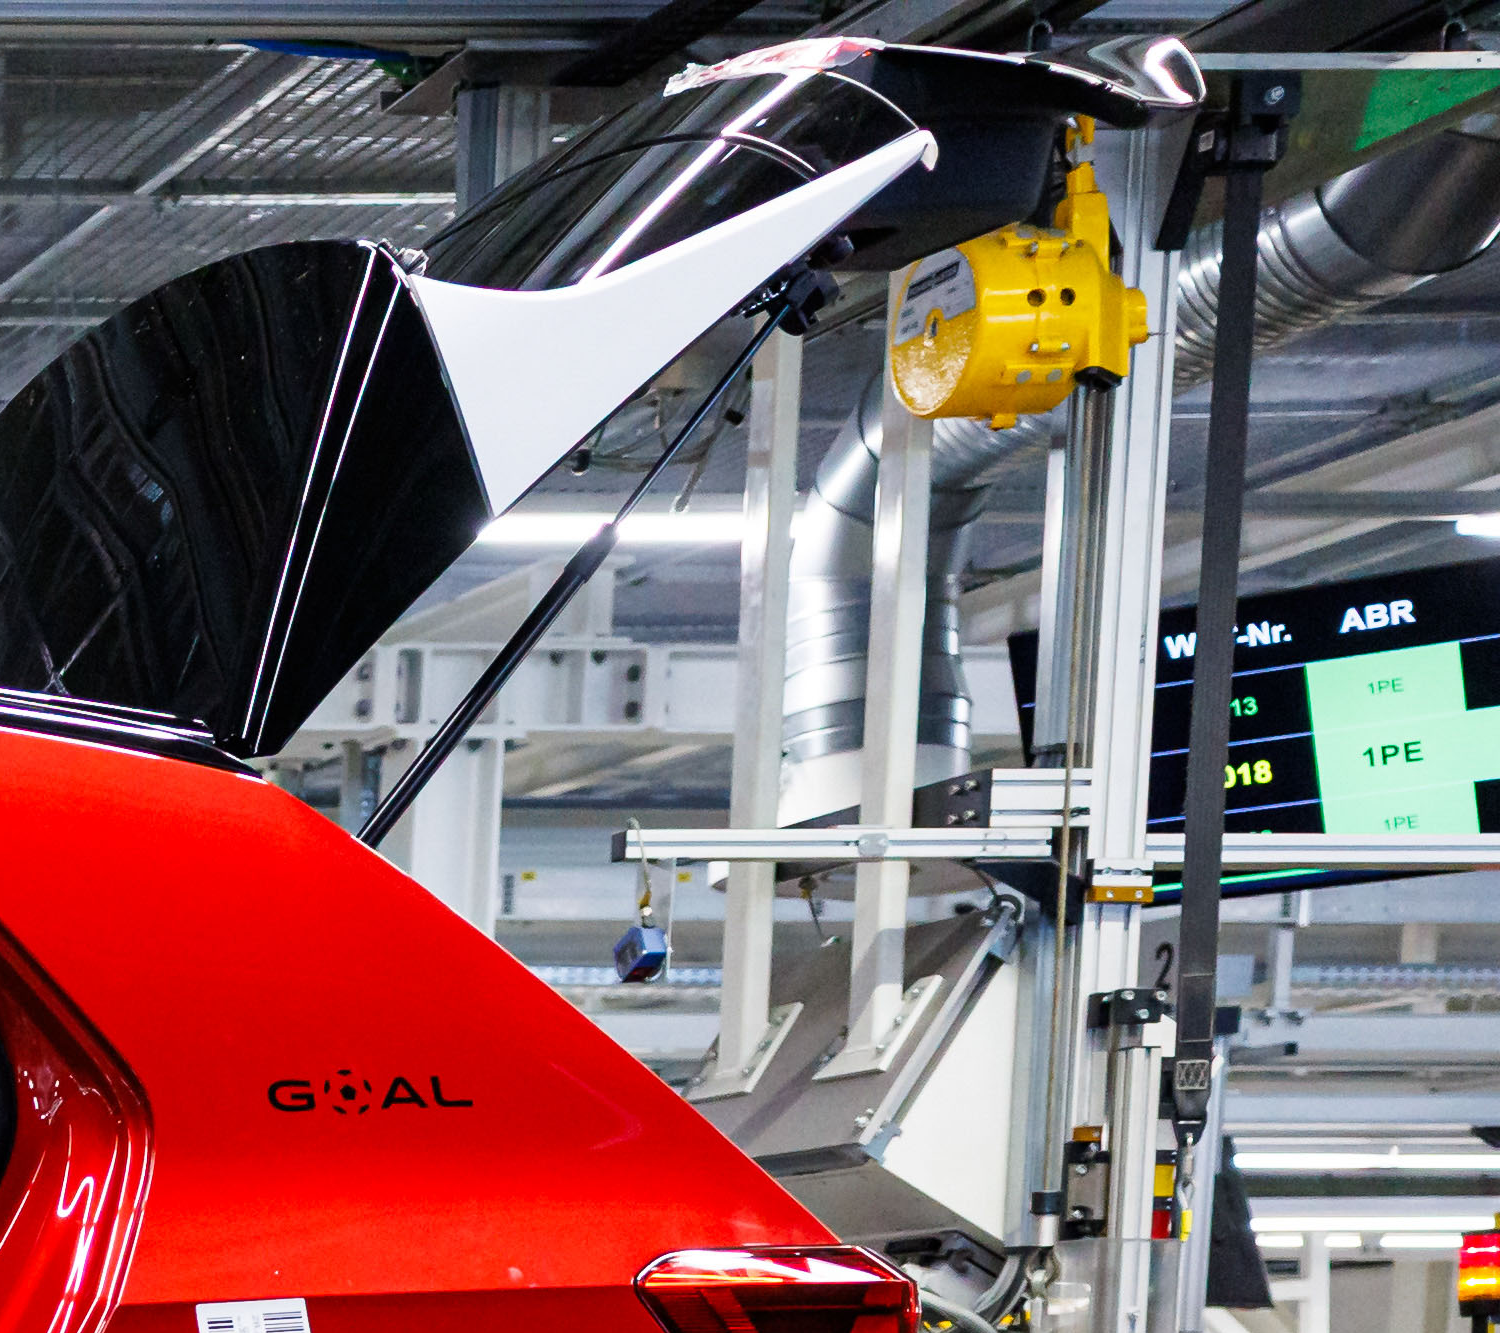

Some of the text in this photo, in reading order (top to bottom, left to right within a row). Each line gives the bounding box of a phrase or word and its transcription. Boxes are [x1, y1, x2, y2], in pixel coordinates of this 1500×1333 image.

[1338, 598, 1417, 634] ABR
[1229, 677, 1405, 718] 13 1PE
[1223, 740, 1425, 789] 018 1PE
[1384, 814, 1420, 832] 1PE
